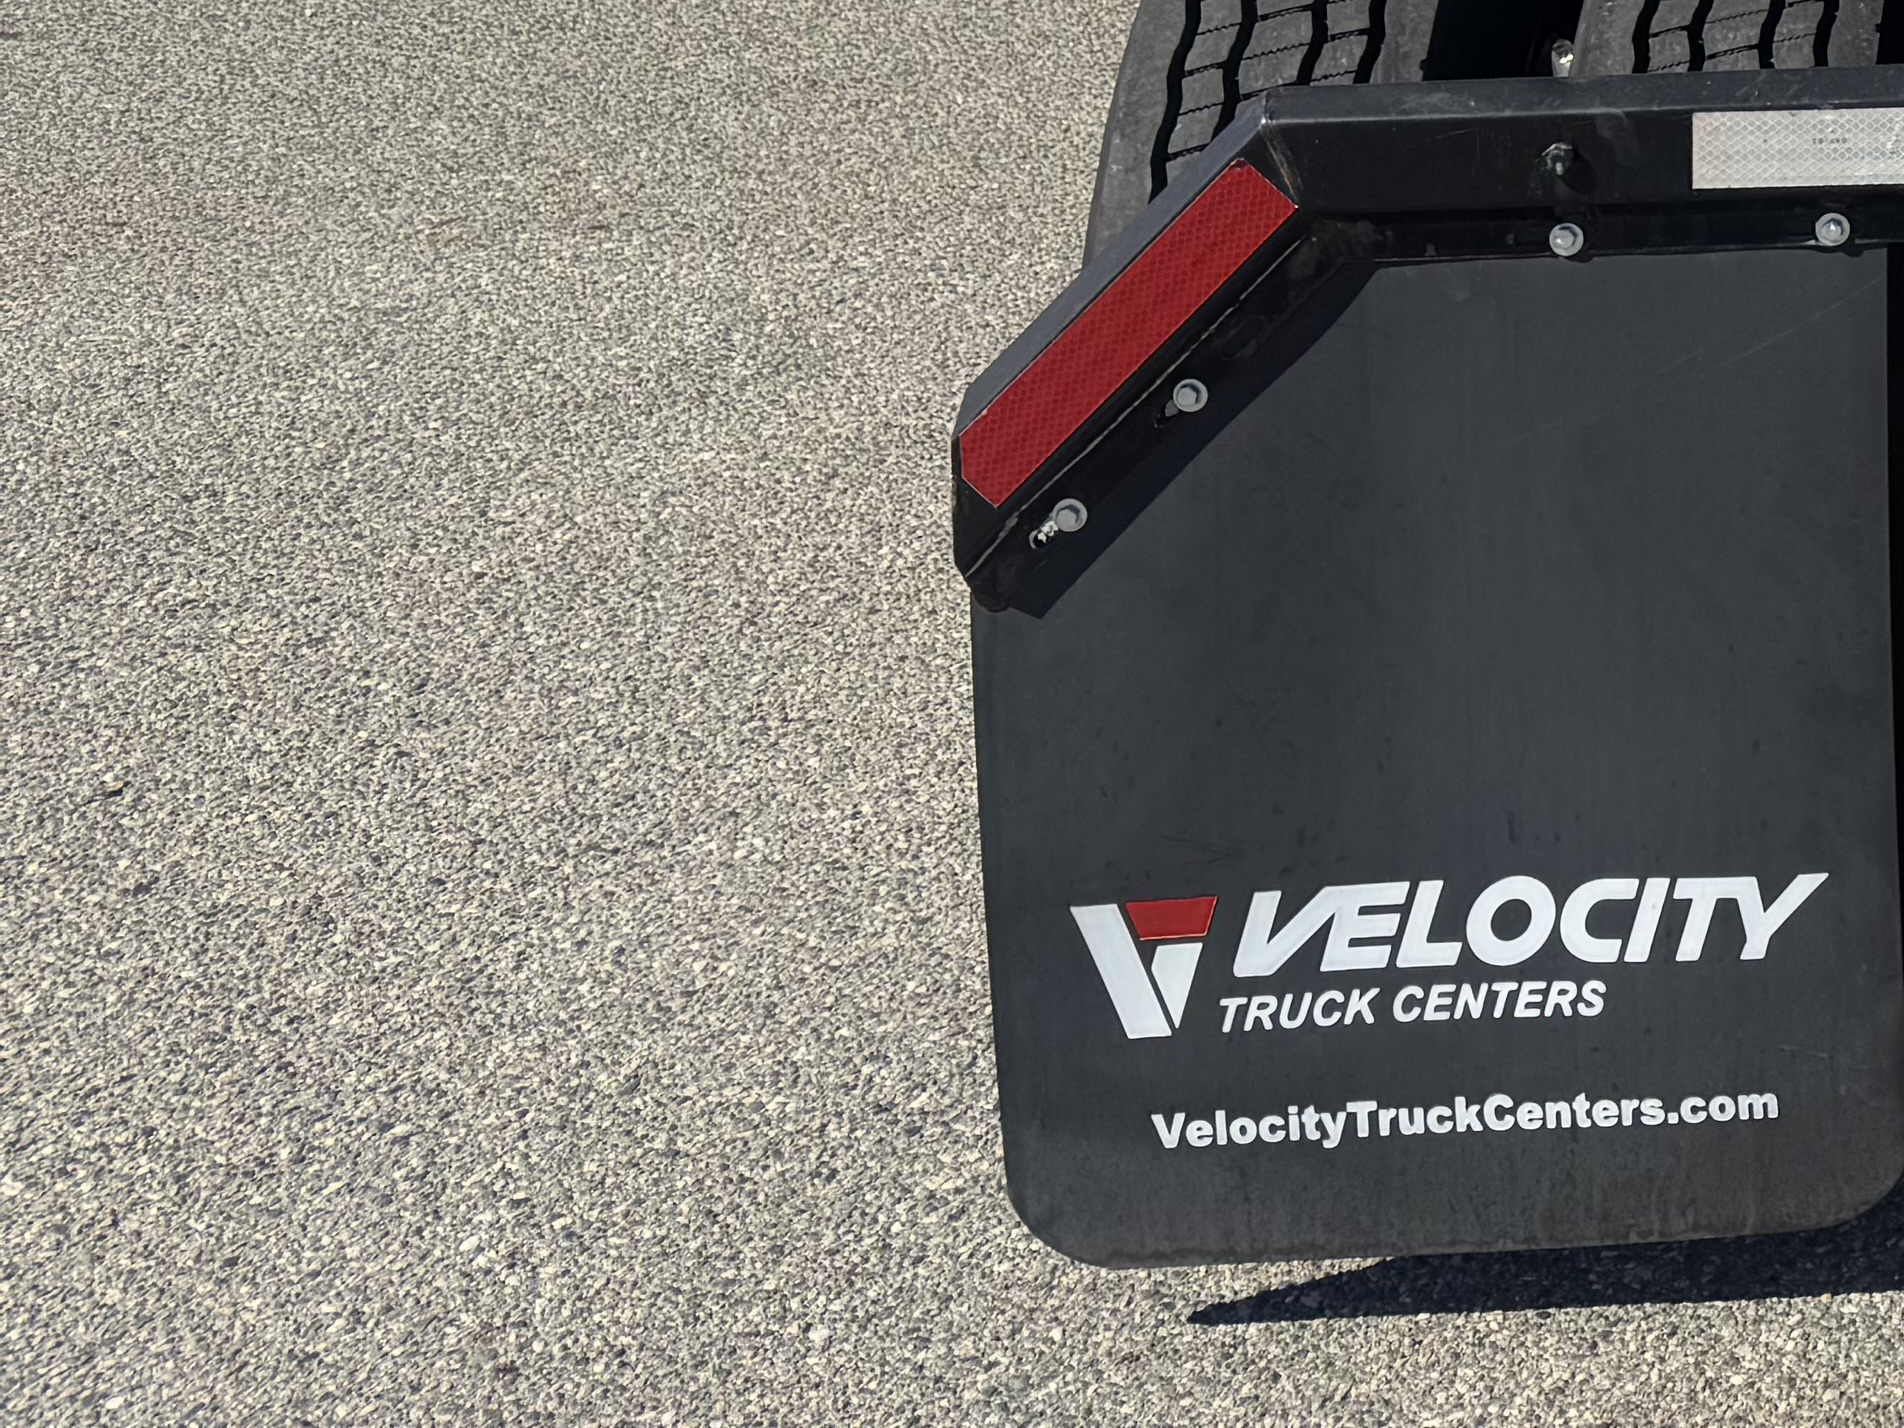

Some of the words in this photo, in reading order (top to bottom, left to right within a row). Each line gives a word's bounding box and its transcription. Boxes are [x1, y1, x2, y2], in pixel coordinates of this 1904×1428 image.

[1232, 872, 1830, 978] VELOCITY
[1219, 987, 1379, 1034] TRUCK
[1392, 980, 1607, 1023] CENTERS
[1150, 1091, 1779, 1149] VelocityTruckCenters.com
